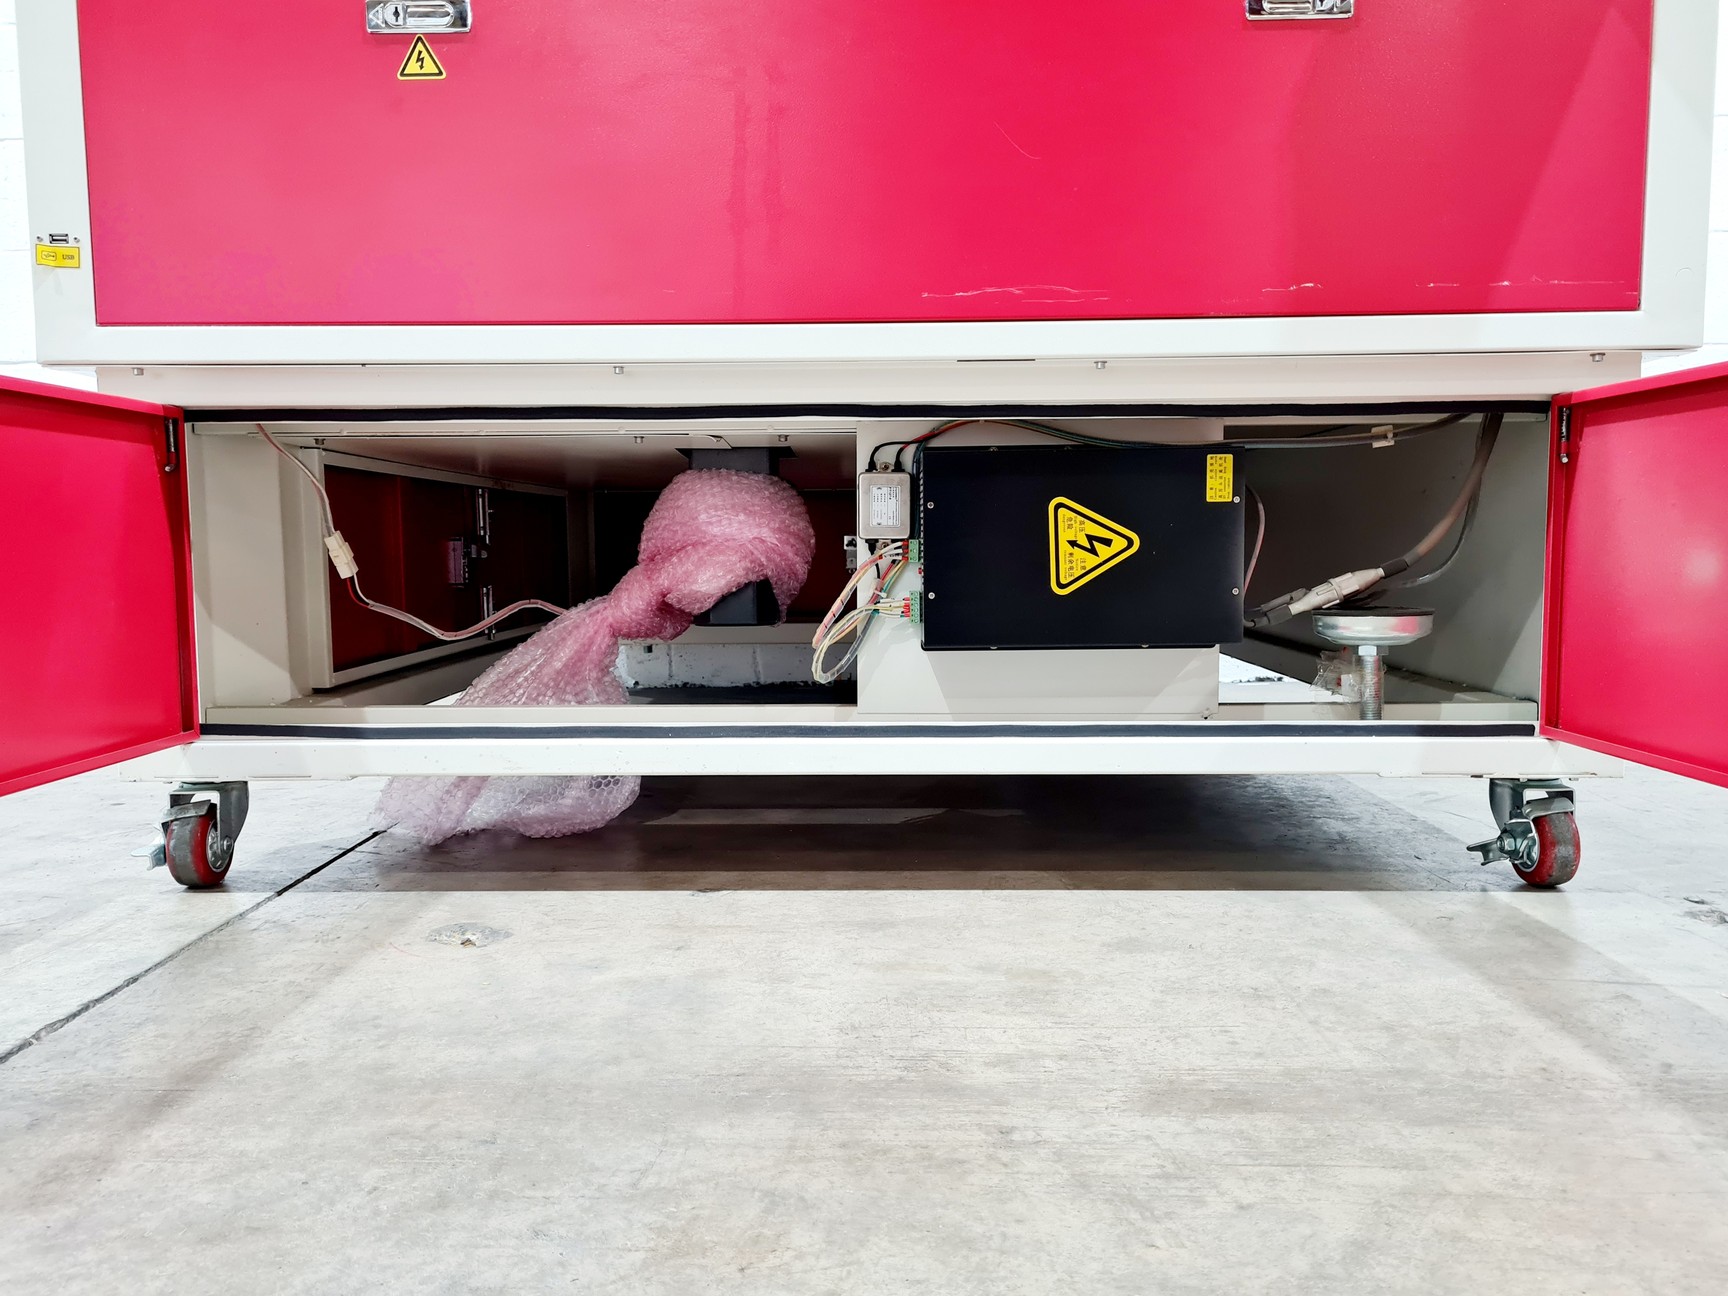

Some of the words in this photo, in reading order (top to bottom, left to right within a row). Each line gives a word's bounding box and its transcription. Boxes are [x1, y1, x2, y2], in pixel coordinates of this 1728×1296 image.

[1067, 516, 1074, 530] 危险
[1079, 519, 1086, 533] 高压
[1080, 557, 1086, 571] 注意
